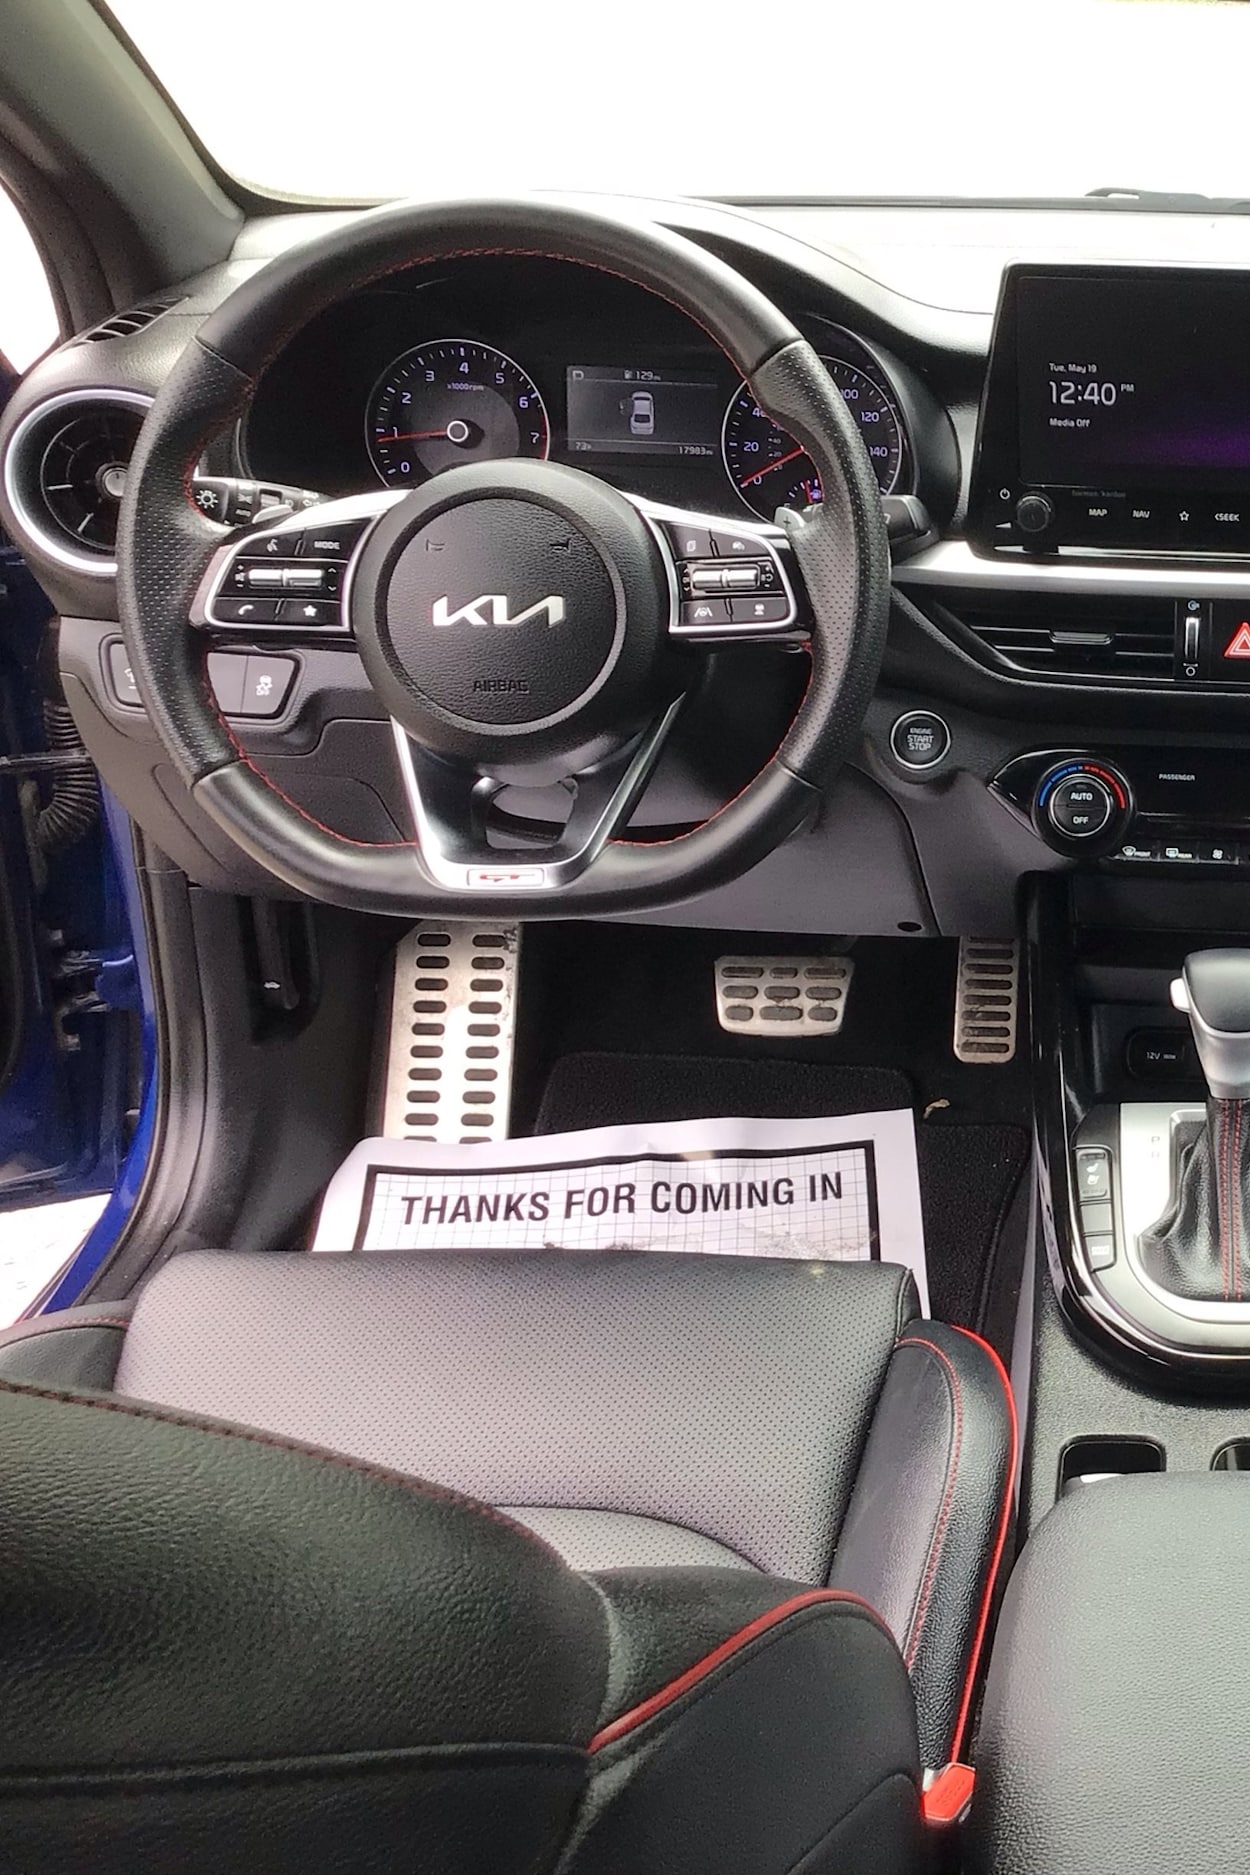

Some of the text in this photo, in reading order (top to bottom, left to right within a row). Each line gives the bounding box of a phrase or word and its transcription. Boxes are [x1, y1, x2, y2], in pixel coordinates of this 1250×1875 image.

[459, 362, 469, 374] 4
[1049, 363, 1097, 373] Tue, May 19
[425, 370, 435, 382] 3
[495, 372, 505, 384] 5
[401, 392, 412, 404] 2
[1049, 381, 1135, 406] 12:40 PM
[519, 397, 529, 409] 6
[861, 412, 879, 422] 120
[1049, 418, 1090, 428] Media Off
[530, 431, 540, 444] 7
[744, 442, 759, 452] 20
[870, 447, 887, 457] 140
[400, 462, 410, 473] 0
[1088, 508, 1108, 517] MAP
[1132, 509, 1150, 518] NAV
[314, 540, 340, 550] MODE
[433, 595, 564, 628] KIA
[473, 680, 529, 694] AIRBAG
[907, 734, 934, 743] START
[908, 742, 931, 751] STOP
[1070, 792, 1093, 801] AUTO
[1072, 816, 1089, 824] OFF
[1146, 1052, 1161, 1060] 12V
[401, 1171, 842, 1225] THANKS FOR COMING IN
